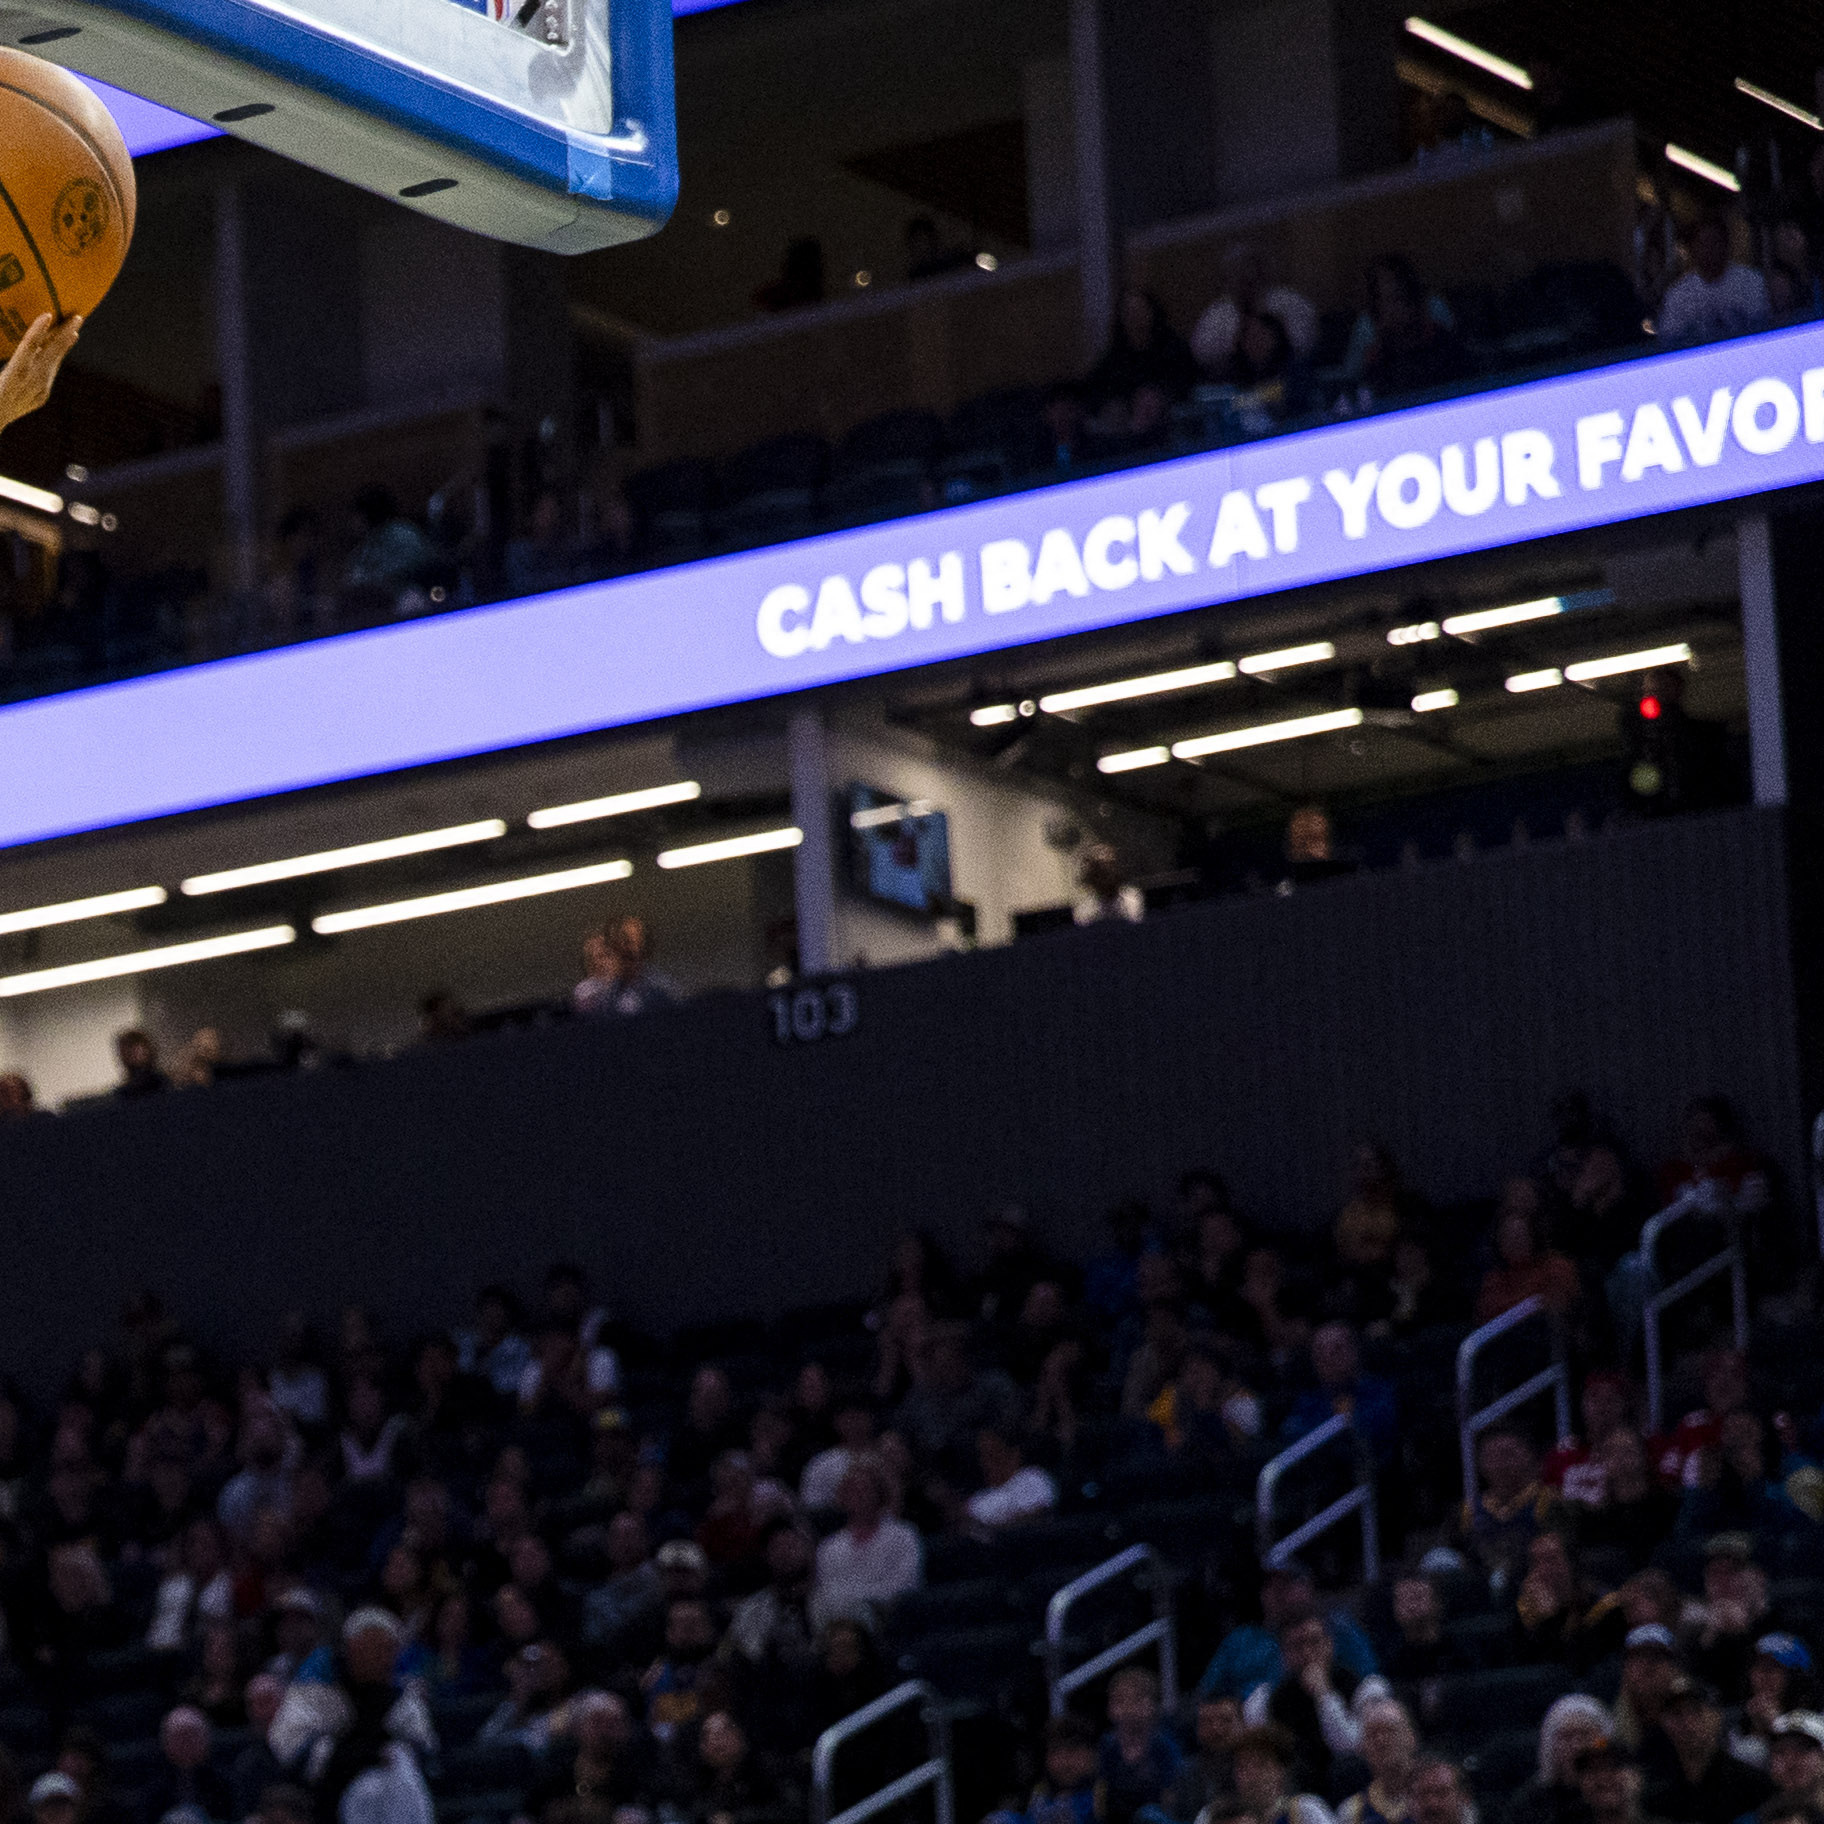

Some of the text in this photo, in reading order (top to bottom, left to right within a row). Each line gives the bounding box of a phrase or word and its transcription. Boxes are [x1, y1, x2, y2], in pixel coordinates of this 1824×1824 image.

[756, 551, 965, 657] CASH
[980, 501, 1196, 614] BACK
[1209, 476, 1311, 568] AT
[1322, 428, 1563, 540] YOUR
[768, 983, 859, 1042] 103
